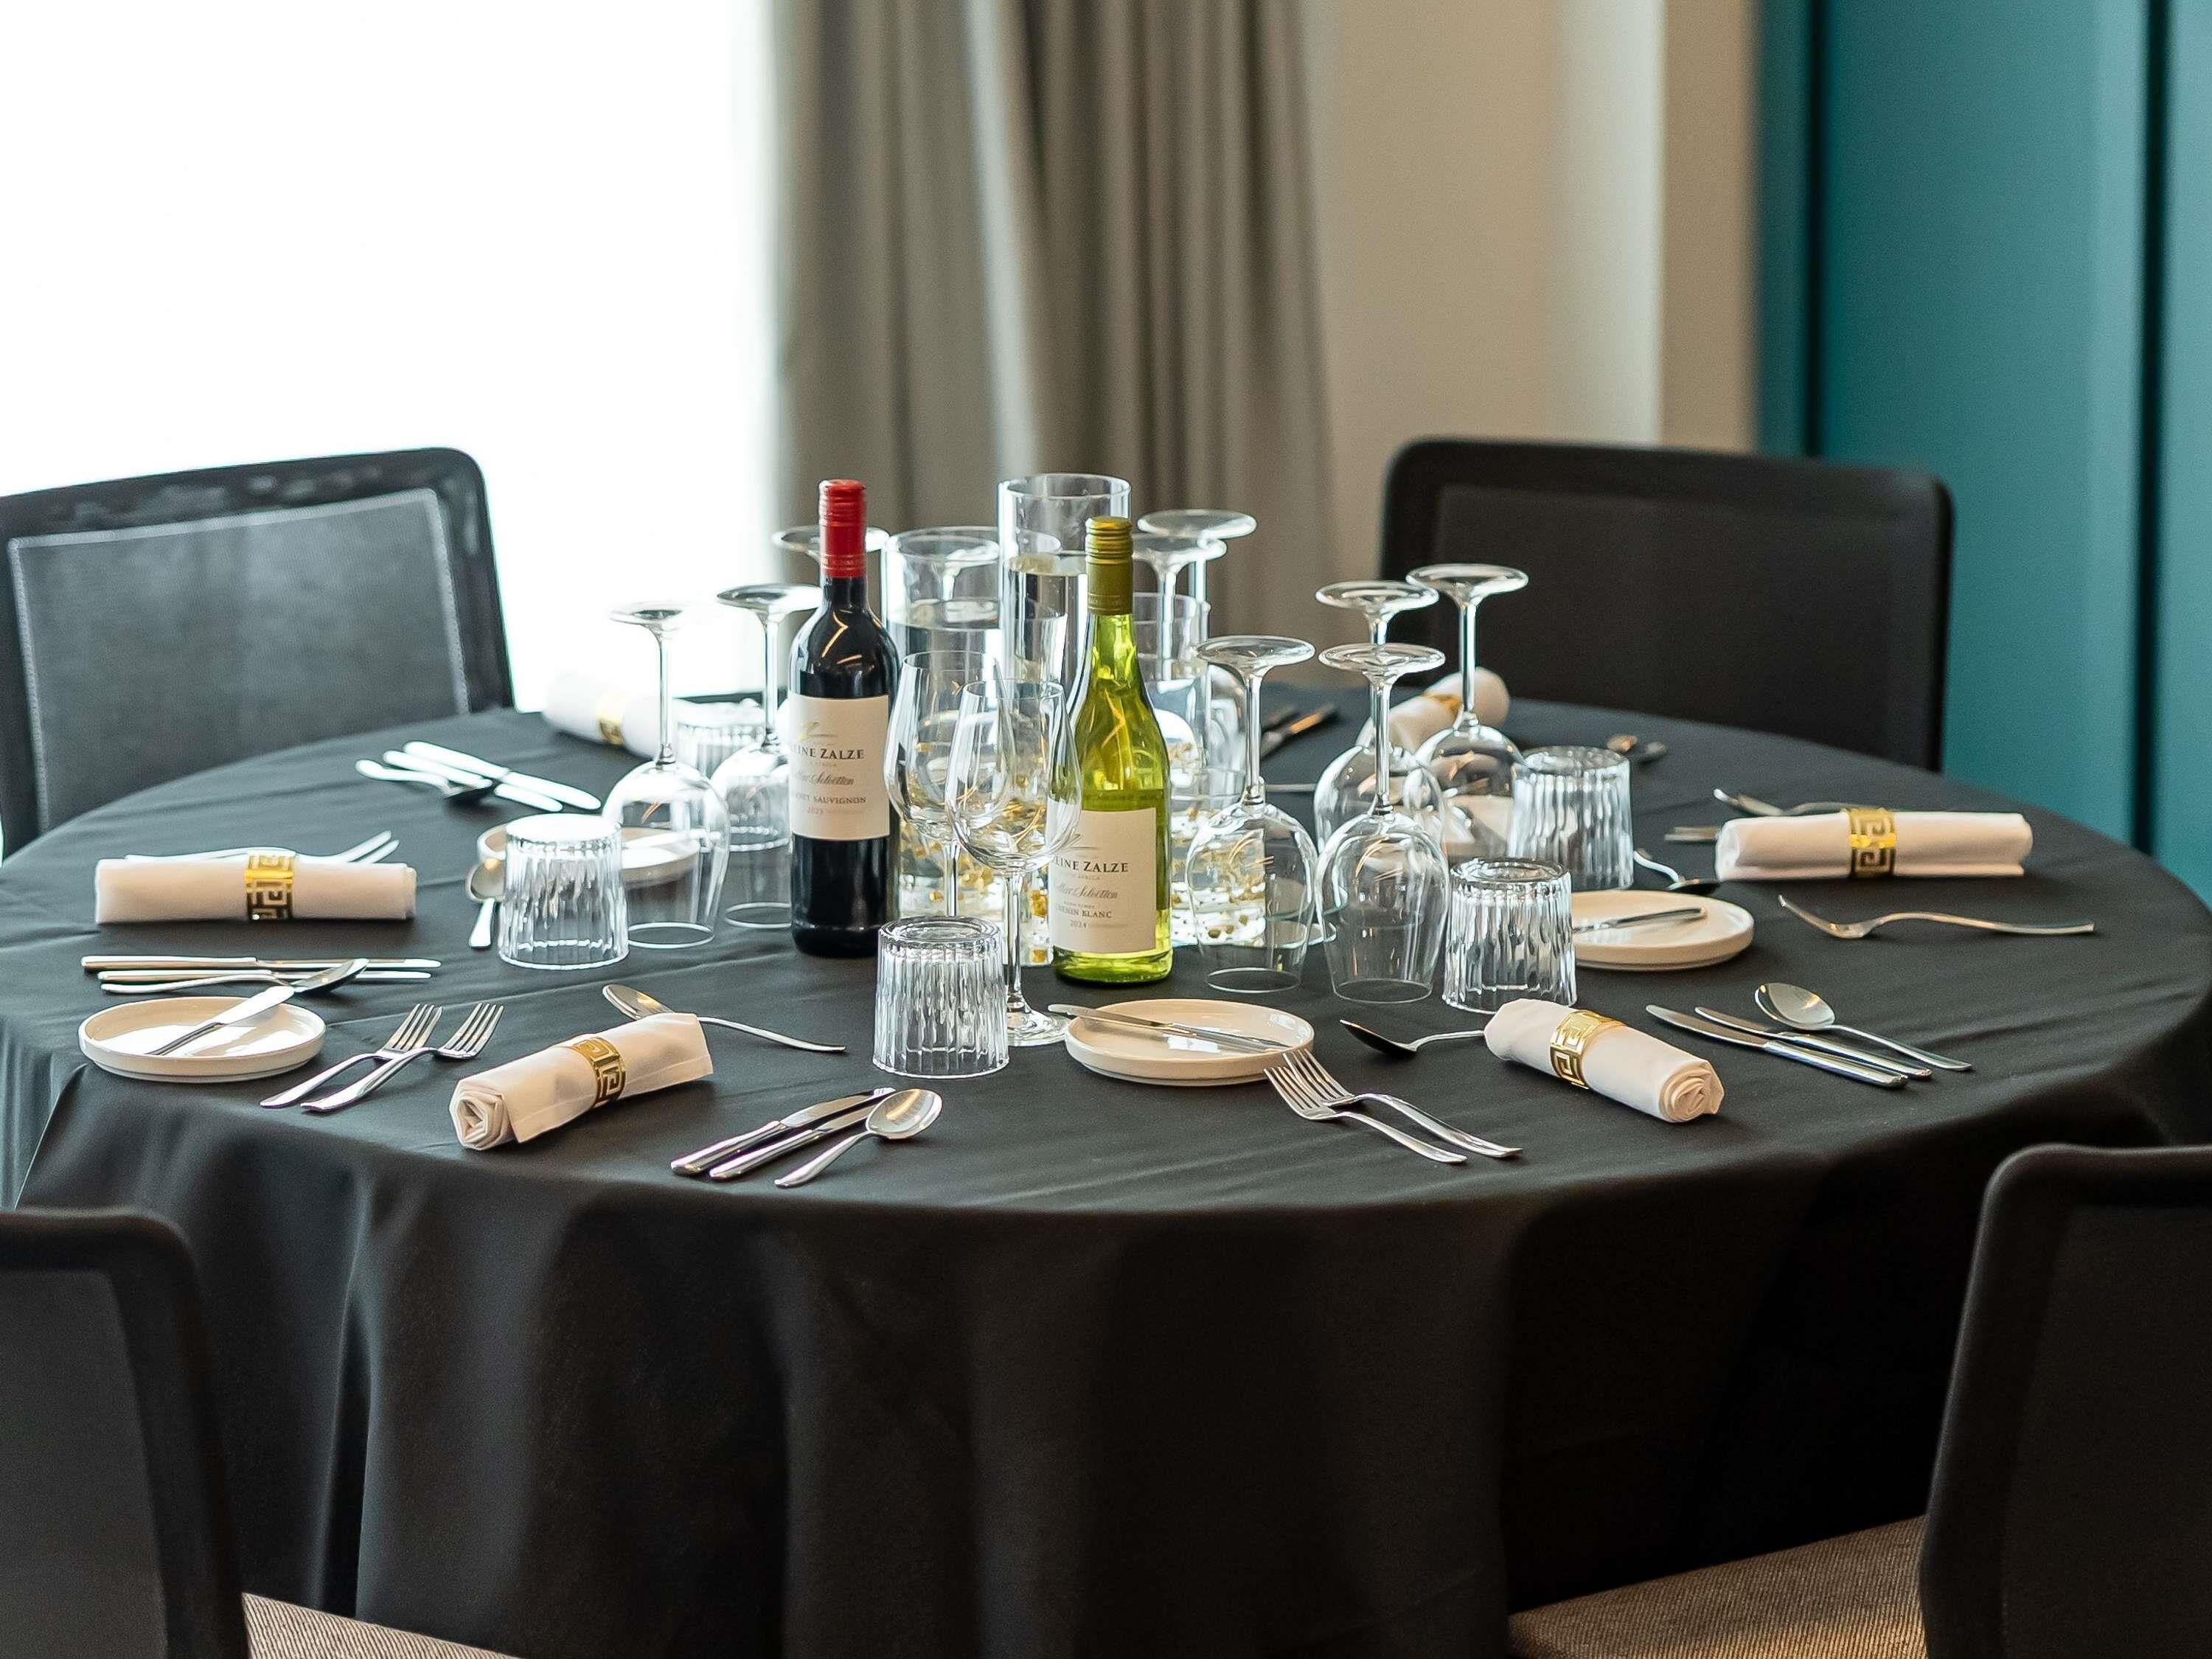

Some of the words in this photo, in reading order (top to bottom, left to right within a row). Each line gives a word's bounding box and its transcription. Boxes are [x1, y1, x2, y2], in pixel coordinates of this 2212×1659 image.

[820, 748, 864, 760] ZALZE
[813, 796, 866, 805] SAUVIGNON
[1082, 860, 1129, 873] ZALZE
[1082, 910, 1112, 919] BLANC
